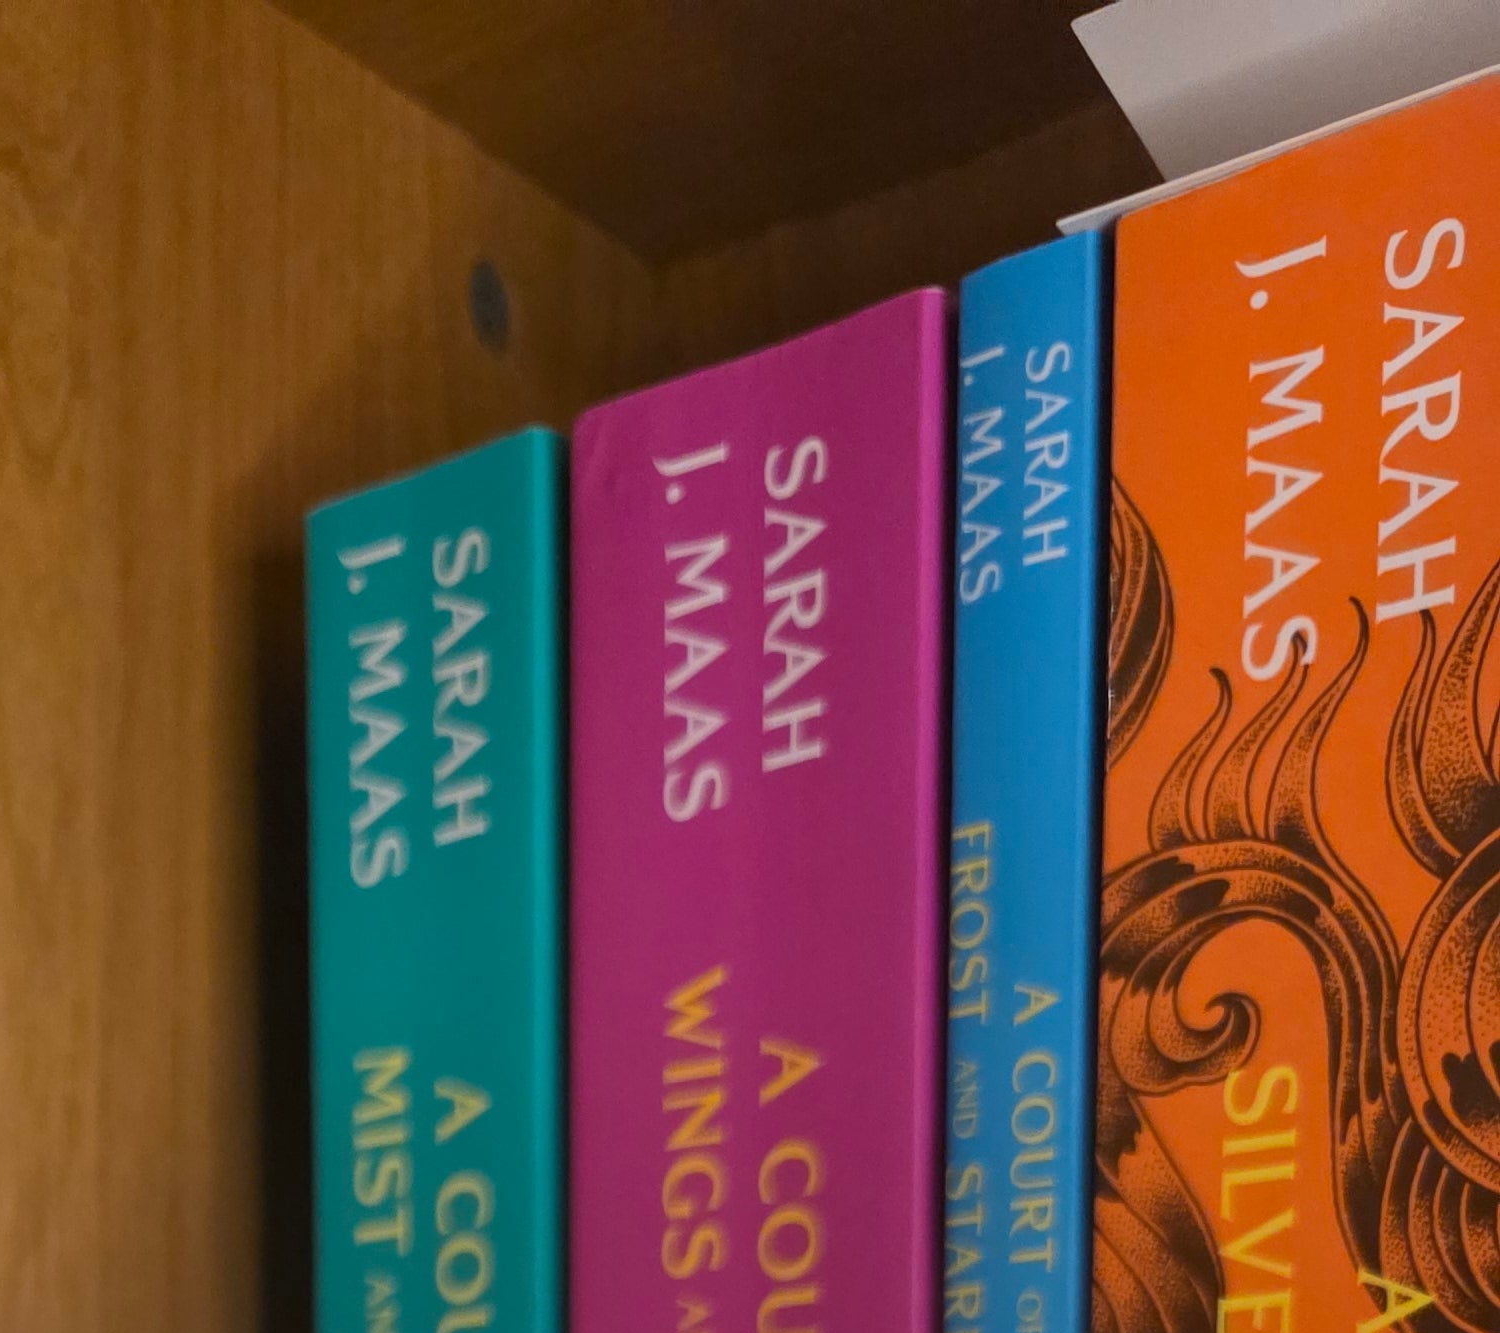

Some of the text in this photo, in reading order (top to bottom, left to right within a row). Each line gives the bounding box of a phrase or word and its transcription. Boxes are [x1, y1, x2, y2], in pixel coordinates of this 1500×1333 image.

[959, 344, 1005, 605] J. MAAS
[1022, 341, 1072, 567] SARAH
[1235, 235, 1328, 681] J. MAAS
[1376, 218, 1466, 625] SARAH
[337, 535, 409, 888] J. MAAS
[433, 527, 490, 847] SARAH
[653, 442, 730, 822] J. MAAS
[761, 437, 827, 772] SARAH
[949, 820, 994, 1026] FROST
[1013, 983, 1060, 1027] A
[353, 1045, 413, 1256] MIST
[434, 1077, 492, 1145] A
[661, 964, 729, 1281] WINGS
[759, 1037, 824, 1108] A
[952, 1057, 979, 1139] AND
[1008, 1049, 1059, 1273] COURT
